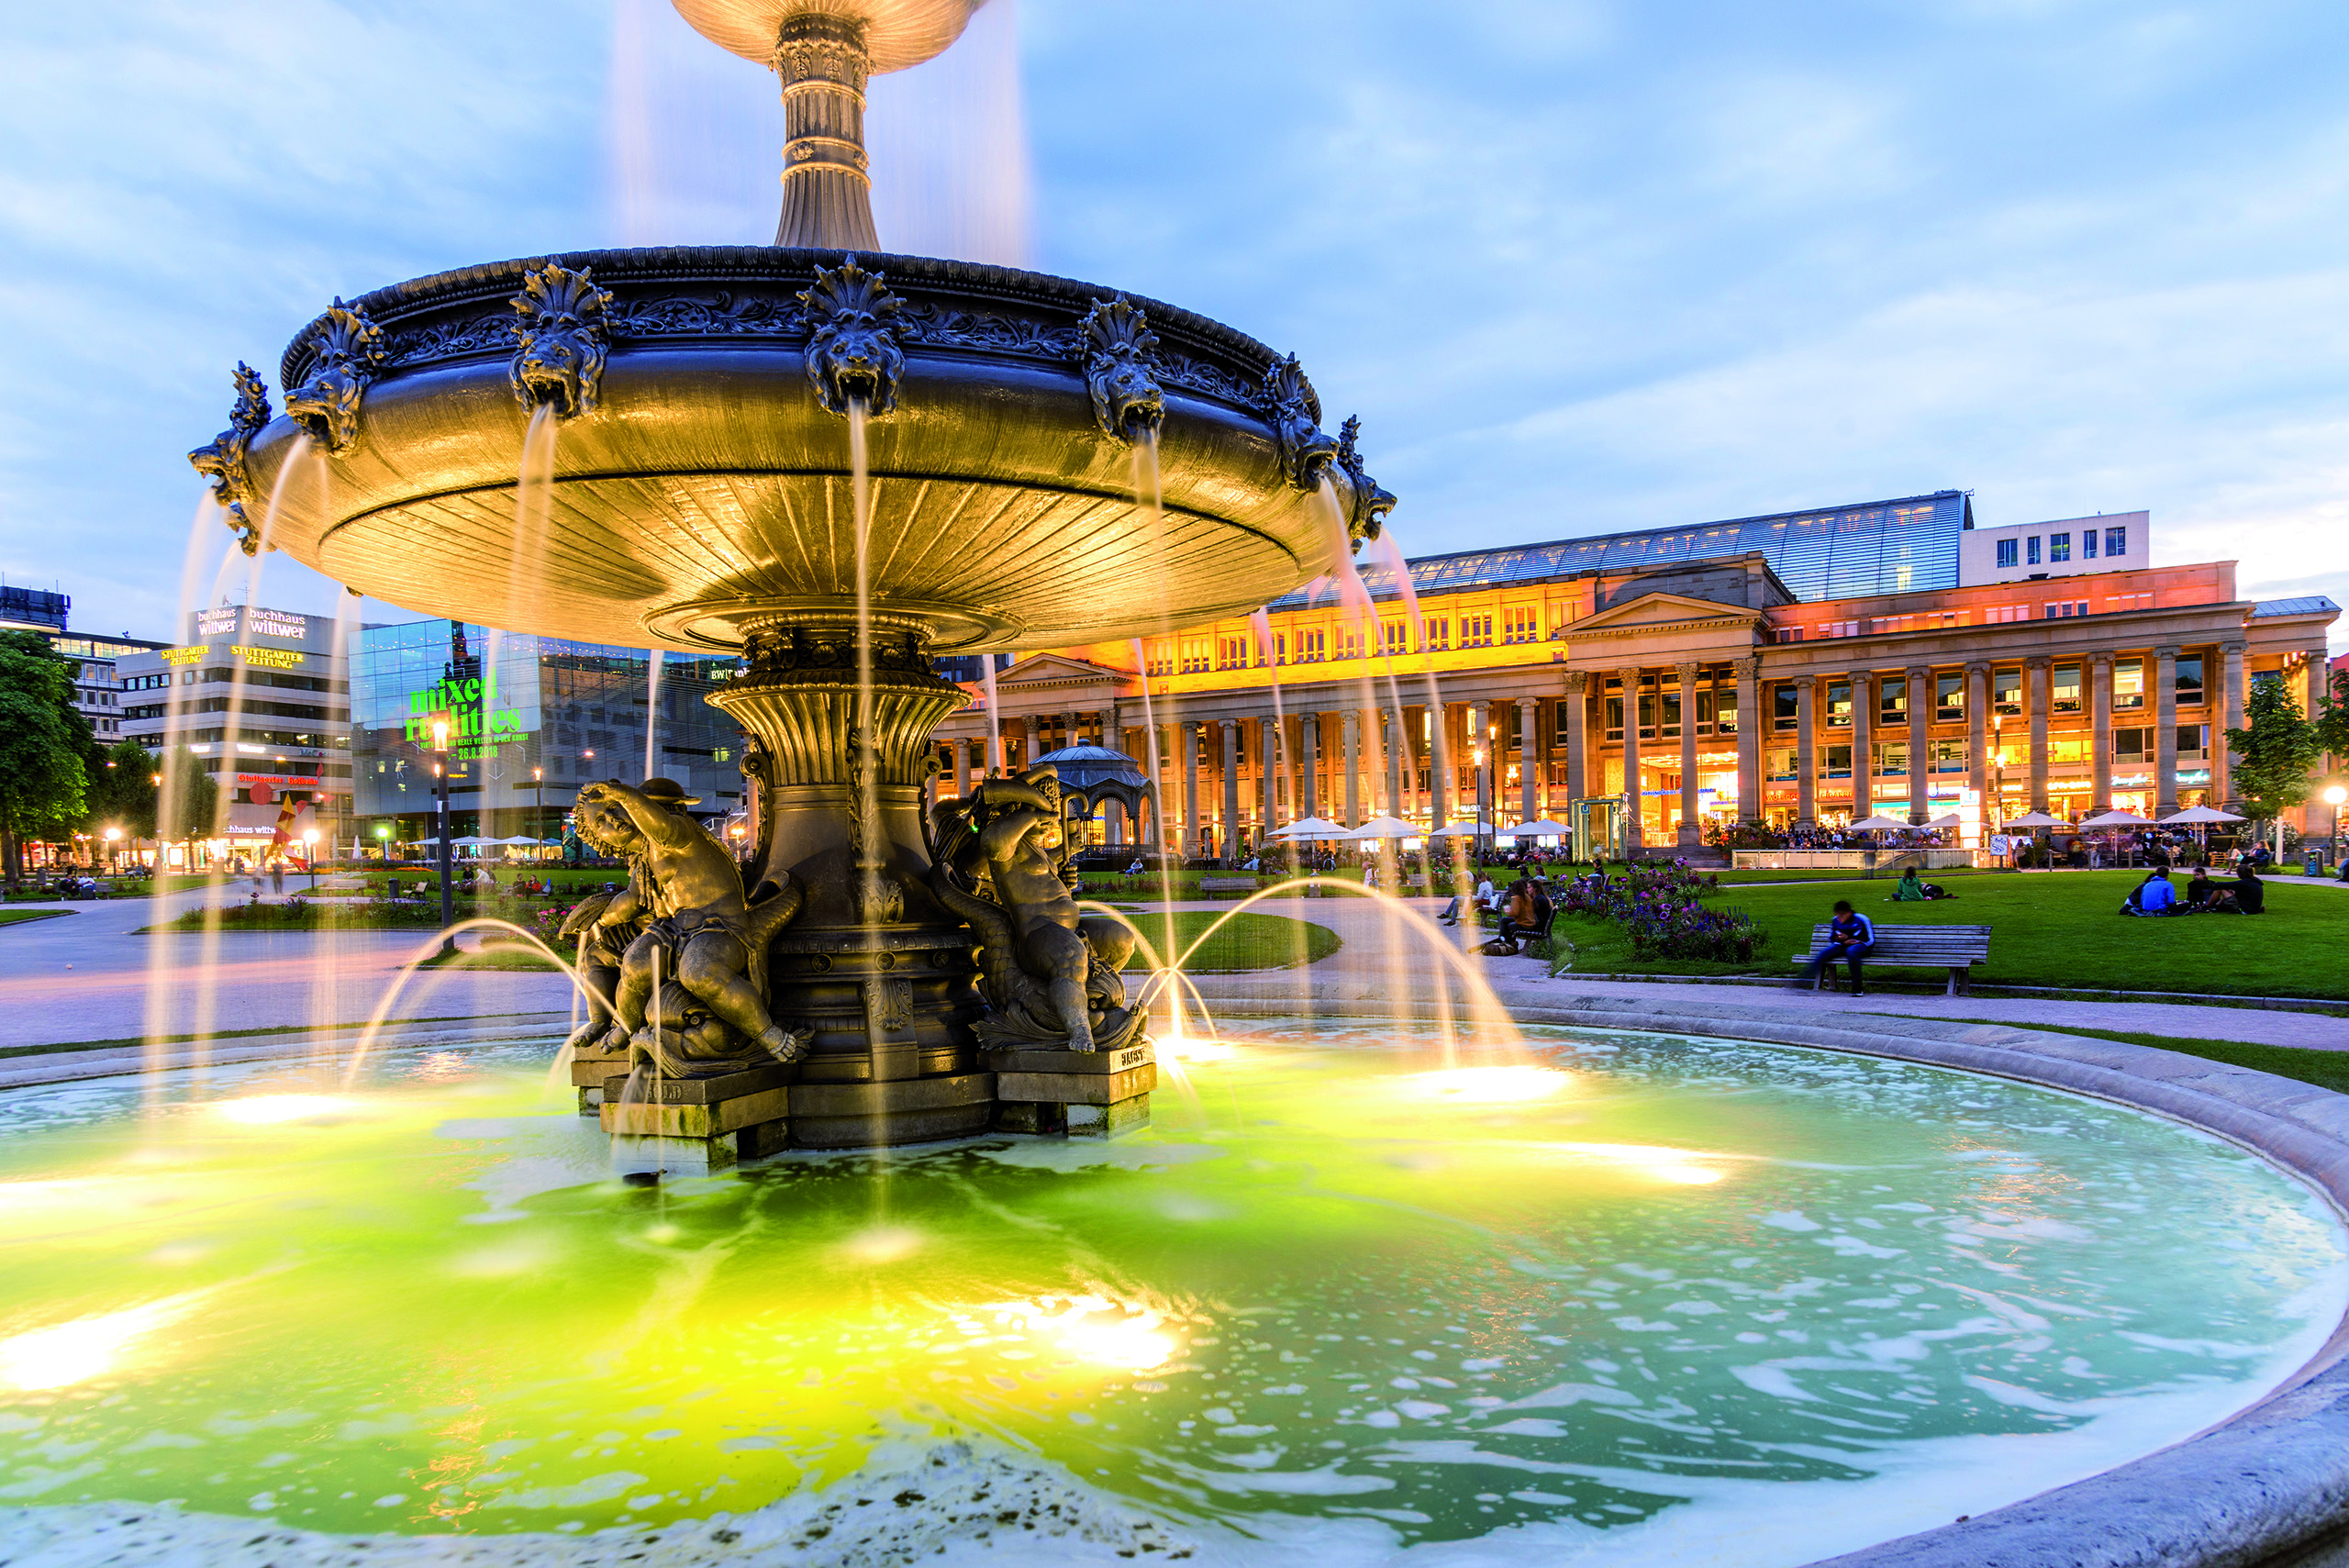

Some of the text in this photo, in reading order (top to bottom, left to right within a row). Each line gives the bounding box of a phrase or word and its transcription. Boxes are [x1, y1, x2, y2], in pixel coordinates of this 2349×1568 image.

[198, 608, 237, 622] buchhaus
[249, 607, 306, 625] buchhaus
[198, 619, 237, 636] wittwer
[250, 619, 306, 639] wittwer
[161, 645, 209, 660] STUTTGARTER
[170, 655, 202, 666] ZEITUNG
[231, 645, 303, 662] STUTTGARTER
[245, 656, 293, 669] ZEITUNG
[409, 667, 498, 713] mixed
[406, 703, 521, 741] relities
[458, 746, 497, 760] 26.8.2018
